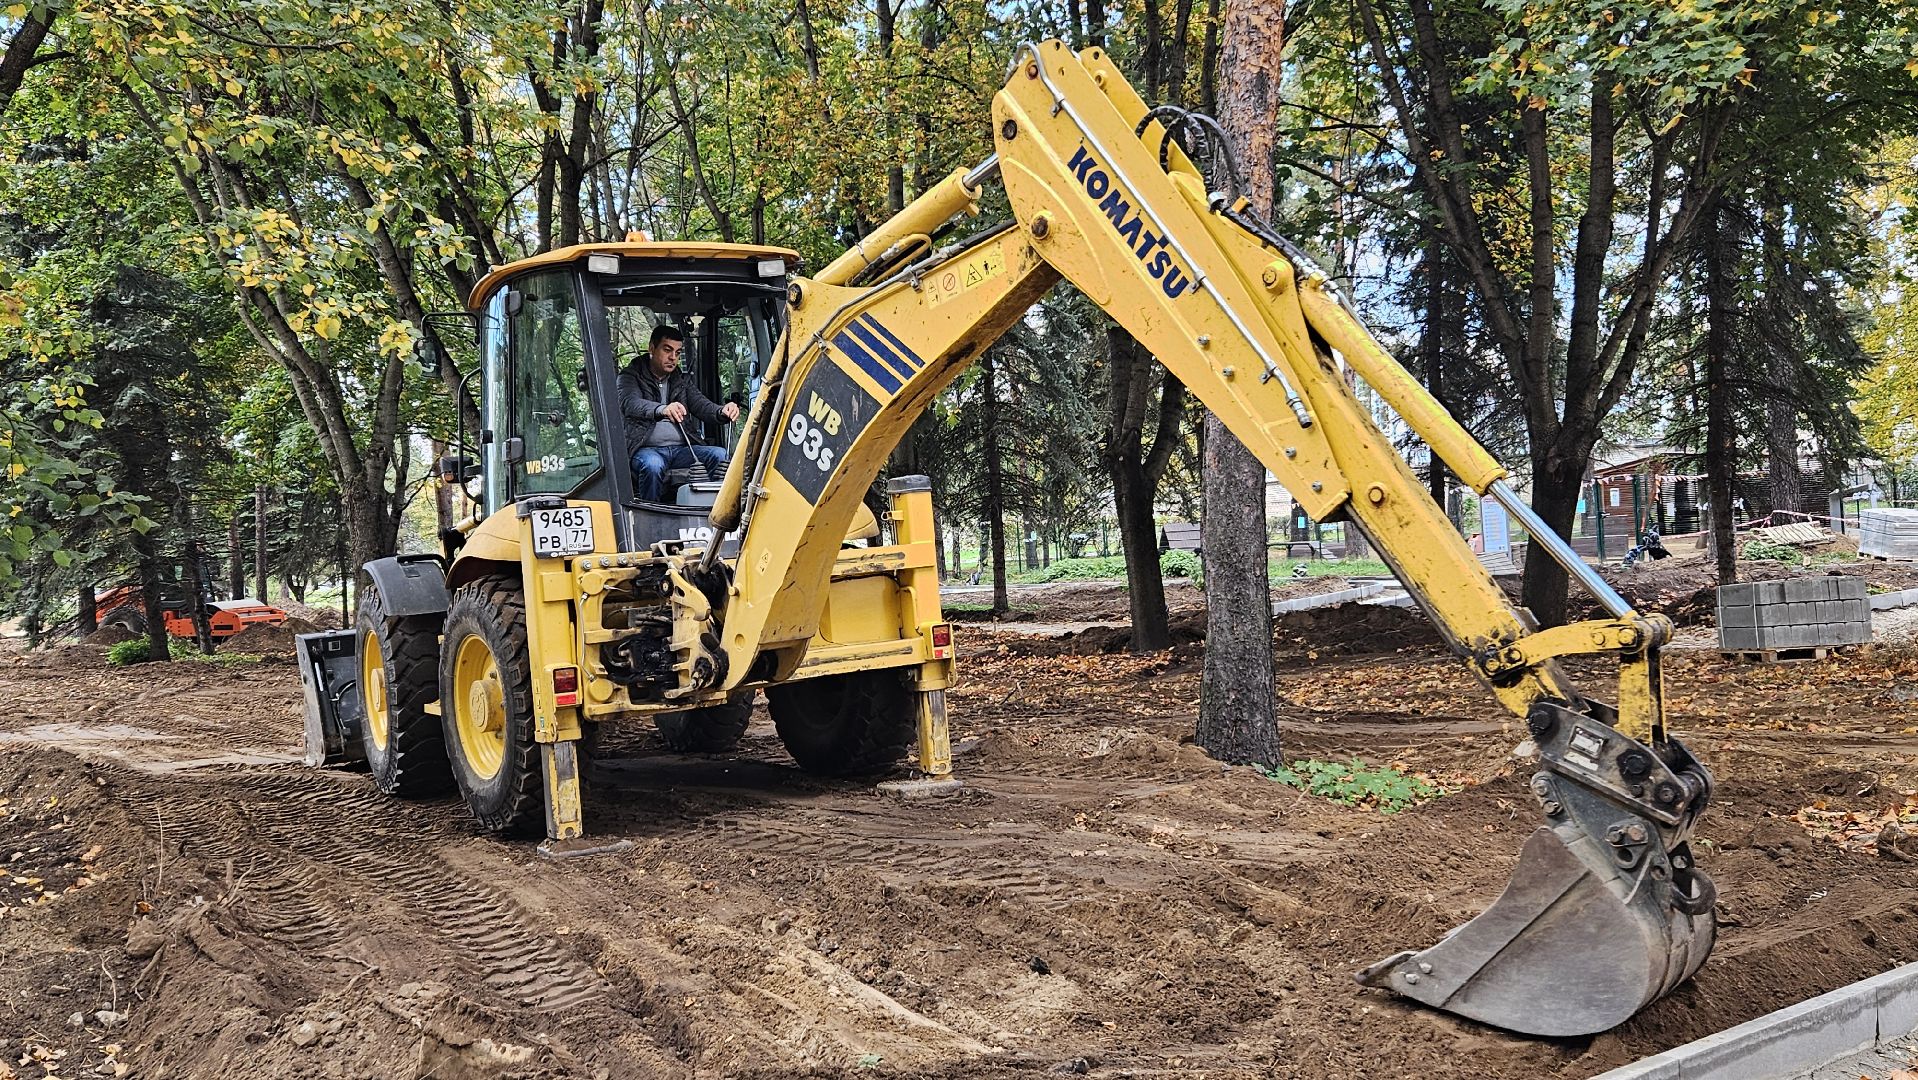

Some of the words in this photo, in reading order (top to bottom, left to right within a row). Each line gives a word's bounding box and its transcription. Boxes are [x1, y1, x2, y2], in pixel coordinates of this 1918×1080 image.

[1067, 146, 1189, 298] KOMATSU
[808, 391, 841, 435] WB
[540, 510, 584, 528] 9485
[572, 530, 587, 542] 77
